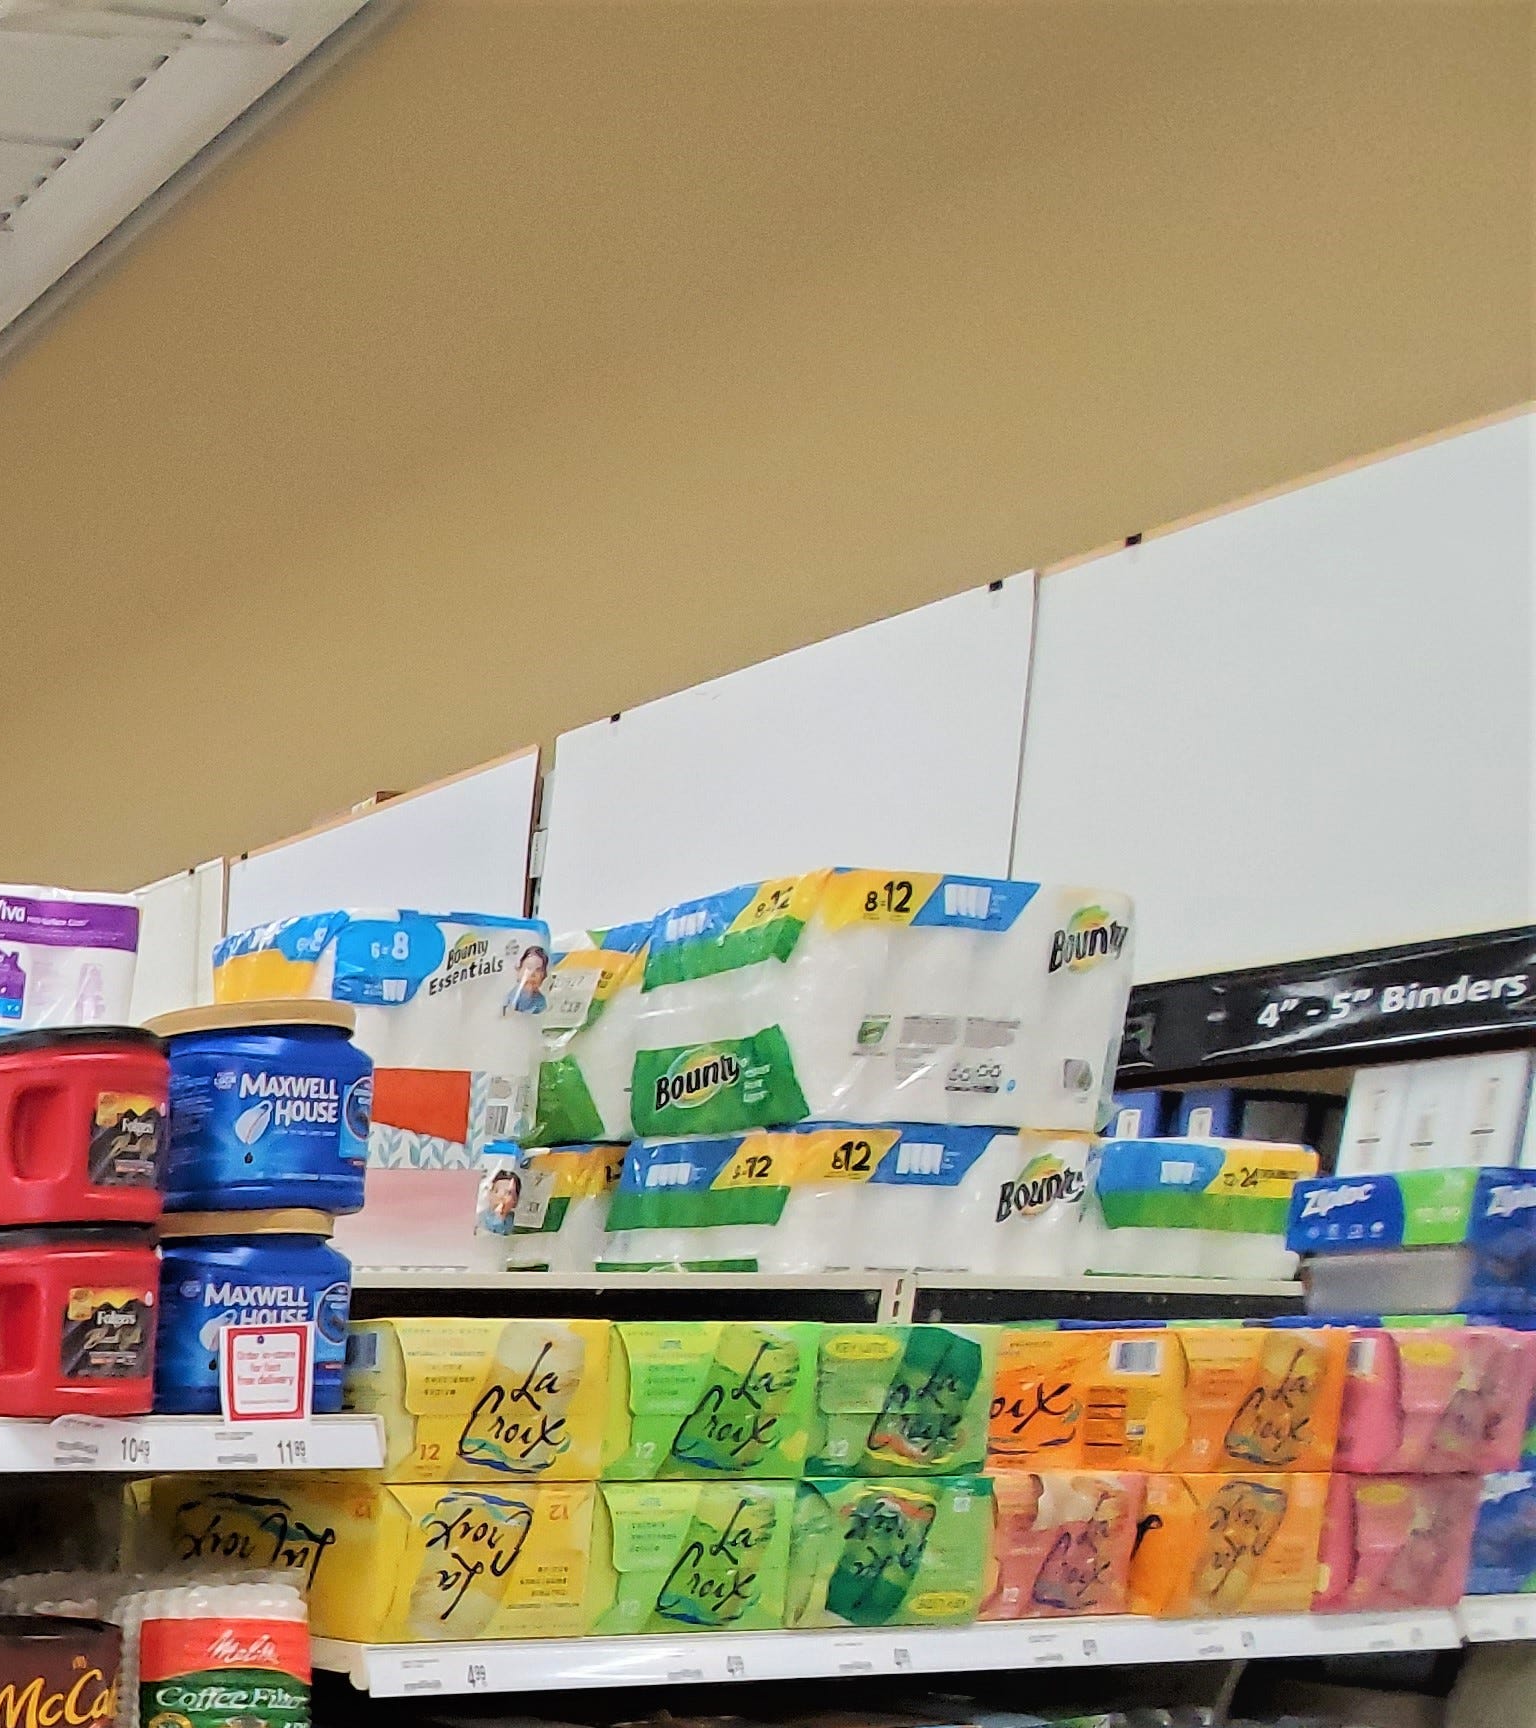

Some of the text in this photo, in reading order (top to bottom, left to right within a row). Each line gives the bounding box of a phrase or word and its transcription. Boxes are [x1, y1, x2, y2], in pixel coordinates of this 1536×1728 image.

[446, 937, 489, 971] Bounty
[428, 955, 505, 996] Essentials
[1380, 972, 1528, 1014] Binders
[239, 1072, 339, 1100] MAXWELL
[654, 1052, 740, 1111] Bounty
[274, 1100, 338, 1126] HOUSE
[203, 1282, 310, 1309] MAXWELL
[512, 1341, 560, 1410] La
[458, 1385, 567, 1460] Croix
[671, 1384, 777, 1456] Croix
[657, 1541, 756, 1612] Croix
[156, 1684, 251, 1712] Coffee
